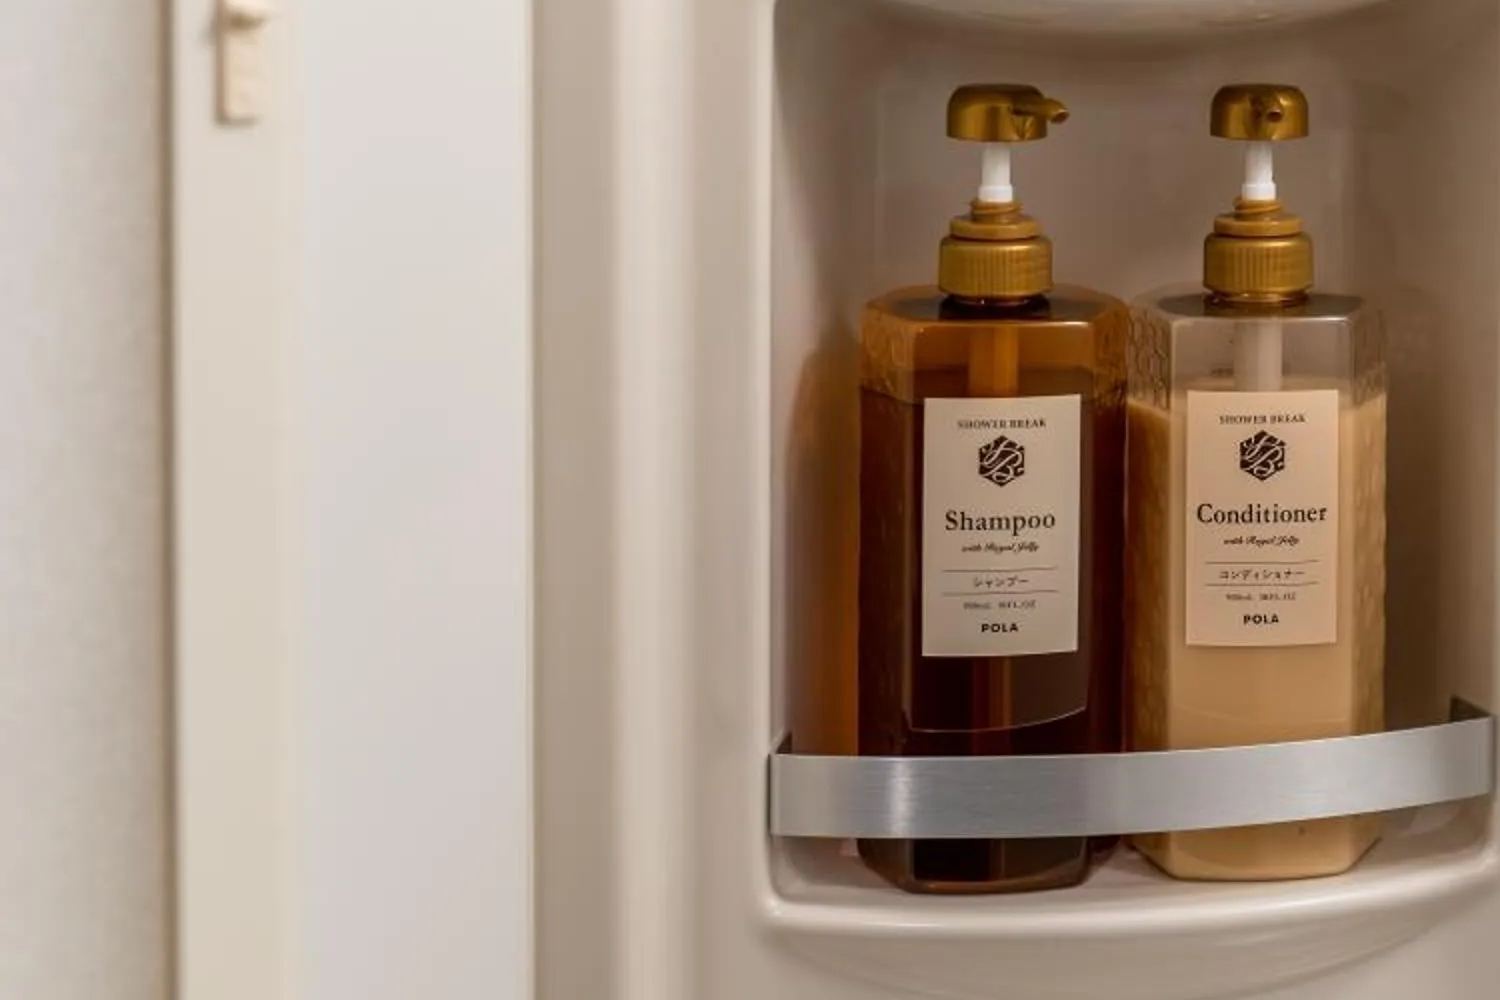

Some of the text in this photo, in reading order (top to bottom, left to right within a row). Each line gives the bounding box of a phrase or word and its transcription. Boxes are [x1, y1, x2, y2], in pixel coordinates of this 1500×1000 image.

[1196, 503, 1328, 525] Conditioner
[945, 509, 1056, 537] Shampoo
[1218, 568, 1306, 581] コンディショナー
[1243, 613, 1280, 625] POLA
[981, 623, 1019, 633] POLA
